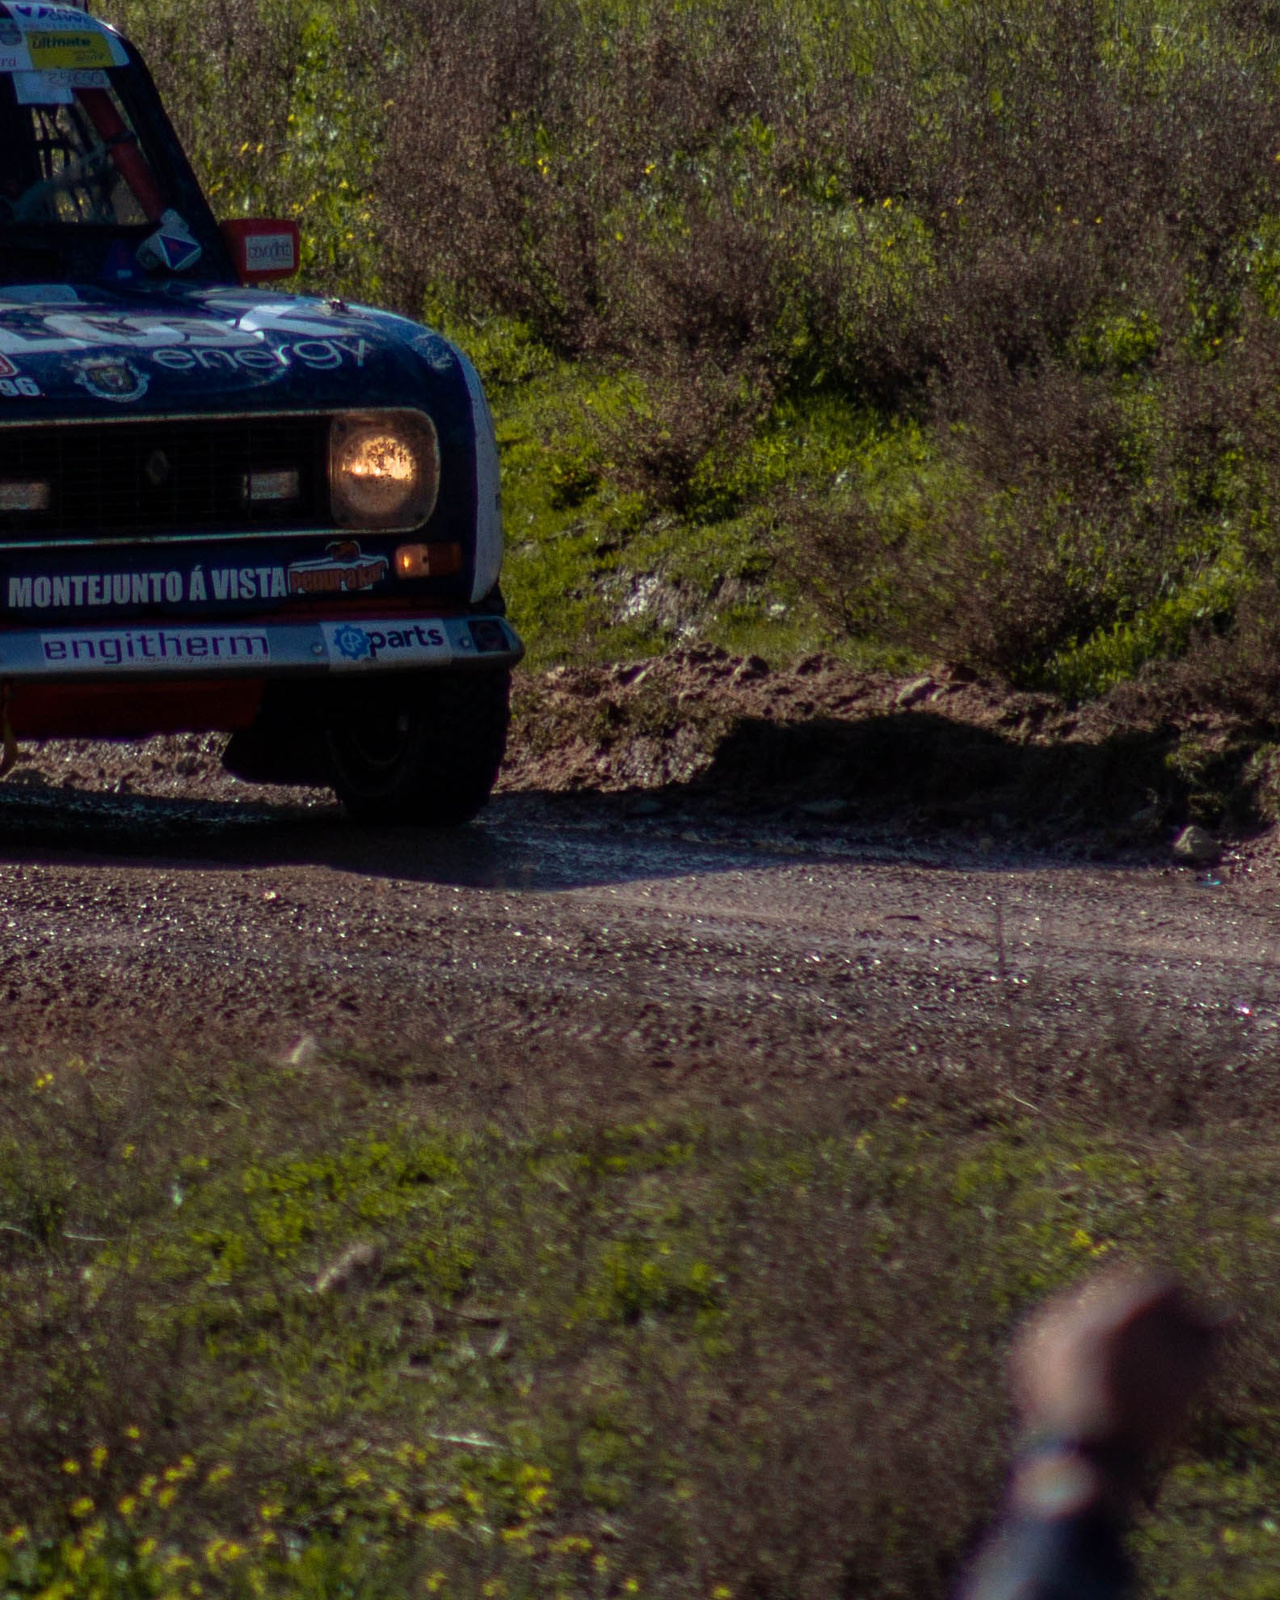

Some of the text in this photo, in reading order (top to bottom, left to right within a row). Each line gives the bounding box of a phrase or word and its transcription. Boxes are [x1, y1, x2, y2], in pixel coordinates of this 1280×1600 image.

[152, 339, 367, 370] energy
[8, 565, 287, 607] MONTEJUNTO Á VISTA
[44, 632, 271, 665] engitherm
[368, 626, 444, 656] parts
